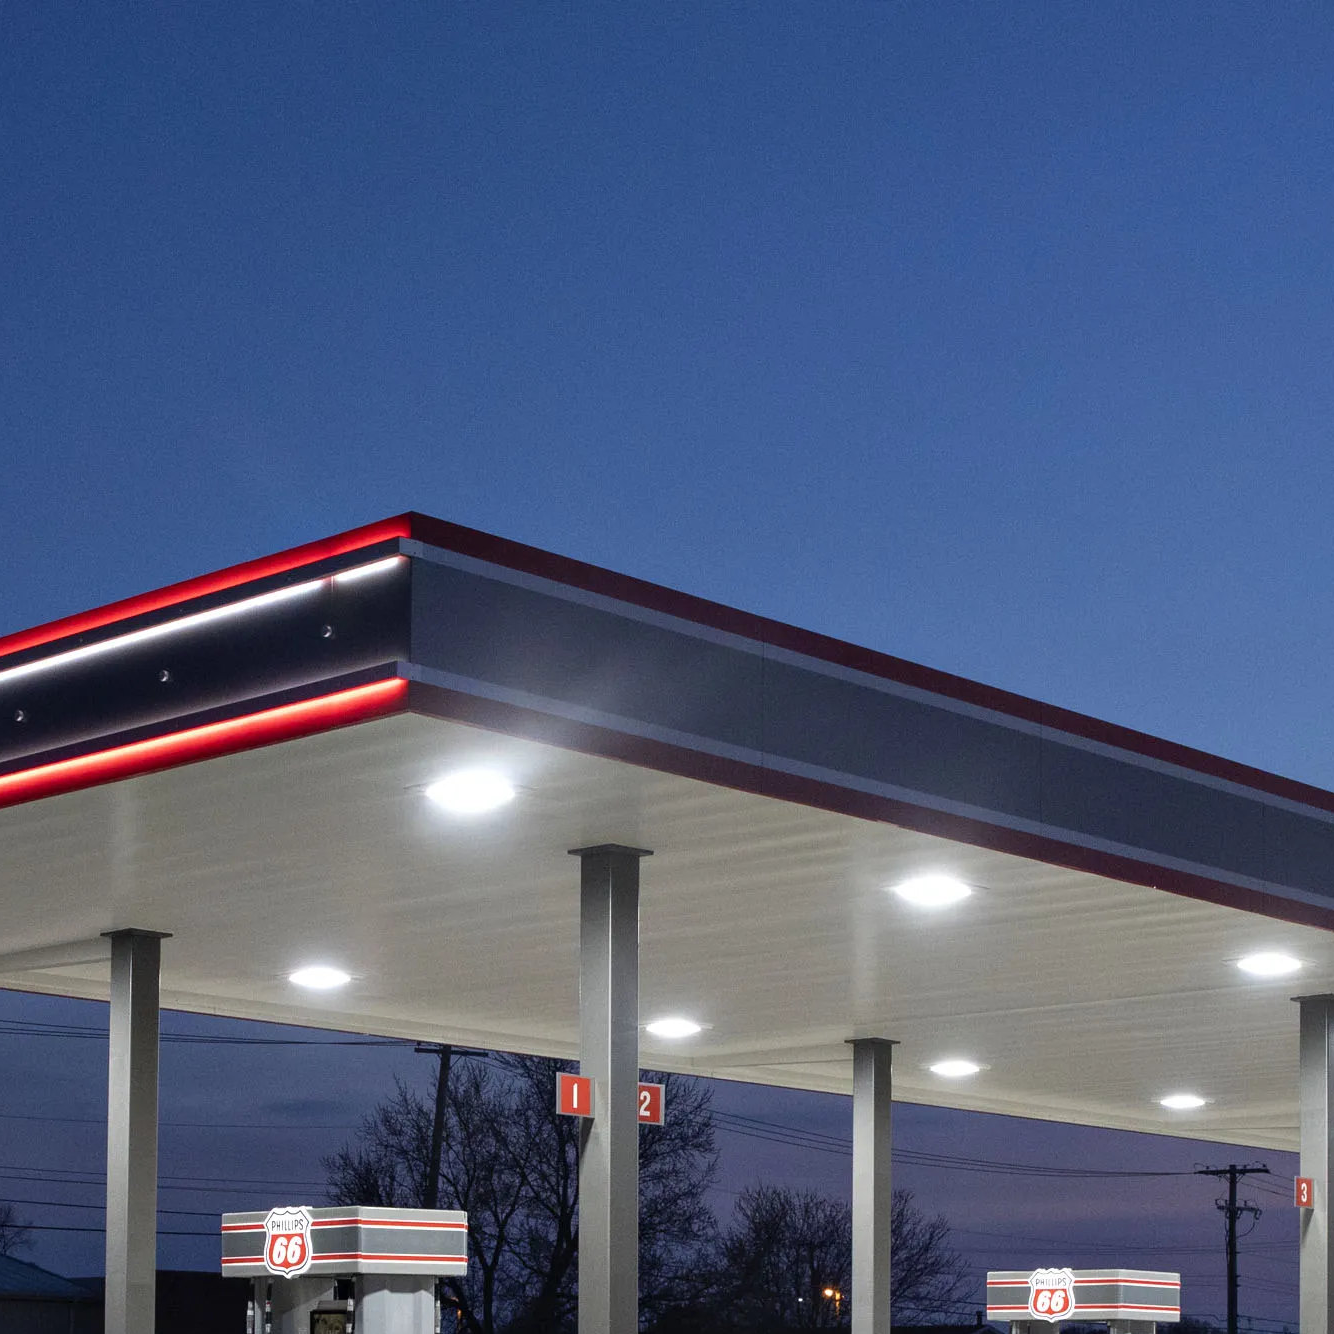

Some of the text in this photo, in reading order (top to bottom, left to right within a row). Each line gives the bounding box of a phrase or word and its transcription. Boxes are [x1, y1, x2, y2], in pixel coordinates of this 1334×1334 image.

[572, 1083, 578, 1109] 1
[639, 1091, 651, 1117] 2
[1301, 1182, 1308, 1203] 3
[271, 1219, 304, 1232] PHILLIPS
[272, 1236, 303, 1265] 66
[1035, 1278, 1067, 1287] PHILLIPS
[1037, 1290, 1066, 1312] 66
